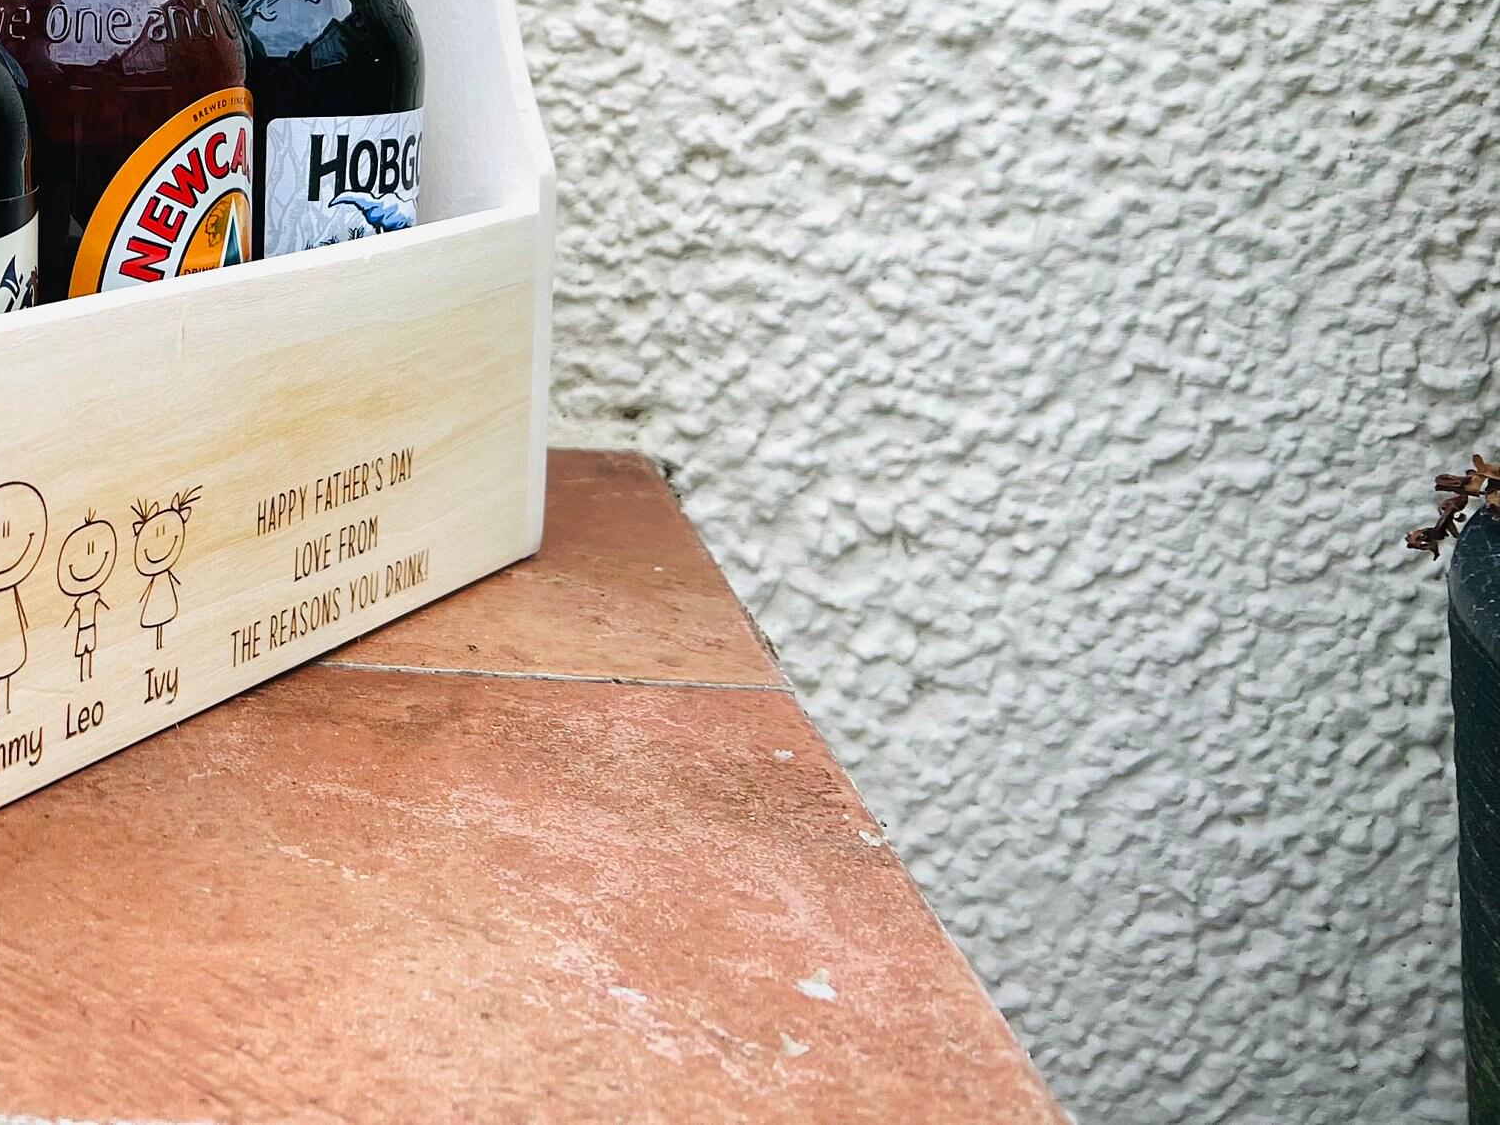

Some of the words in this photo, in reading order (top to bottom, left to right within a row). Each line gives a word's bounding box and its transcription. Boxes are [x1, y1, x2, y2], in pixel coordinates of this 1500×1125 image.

[45, 2, 133, 44] one
[192, 98, 228, 123] BREWED
[307, 131, 422, 202] HOBG
[118, 127, 252, 283] NEWCA
[256, 484, 308, 537] HAPPY
[314, 456, 384, 515] FATHER'S
[389, 446, 414, 486] DAY
[293, 533, 331, 583] LOVE
[338, 514, 379, 564] FROM
[230, 620, 261, 668] THE
[269, 586, 341, 652] REASONS
[349, 570, 379, 614] YOU
[384, 547, 430, 599] DRINK!
[65, 700, 105, 740] Leo
[143, 666, 179, 705] Ivy
